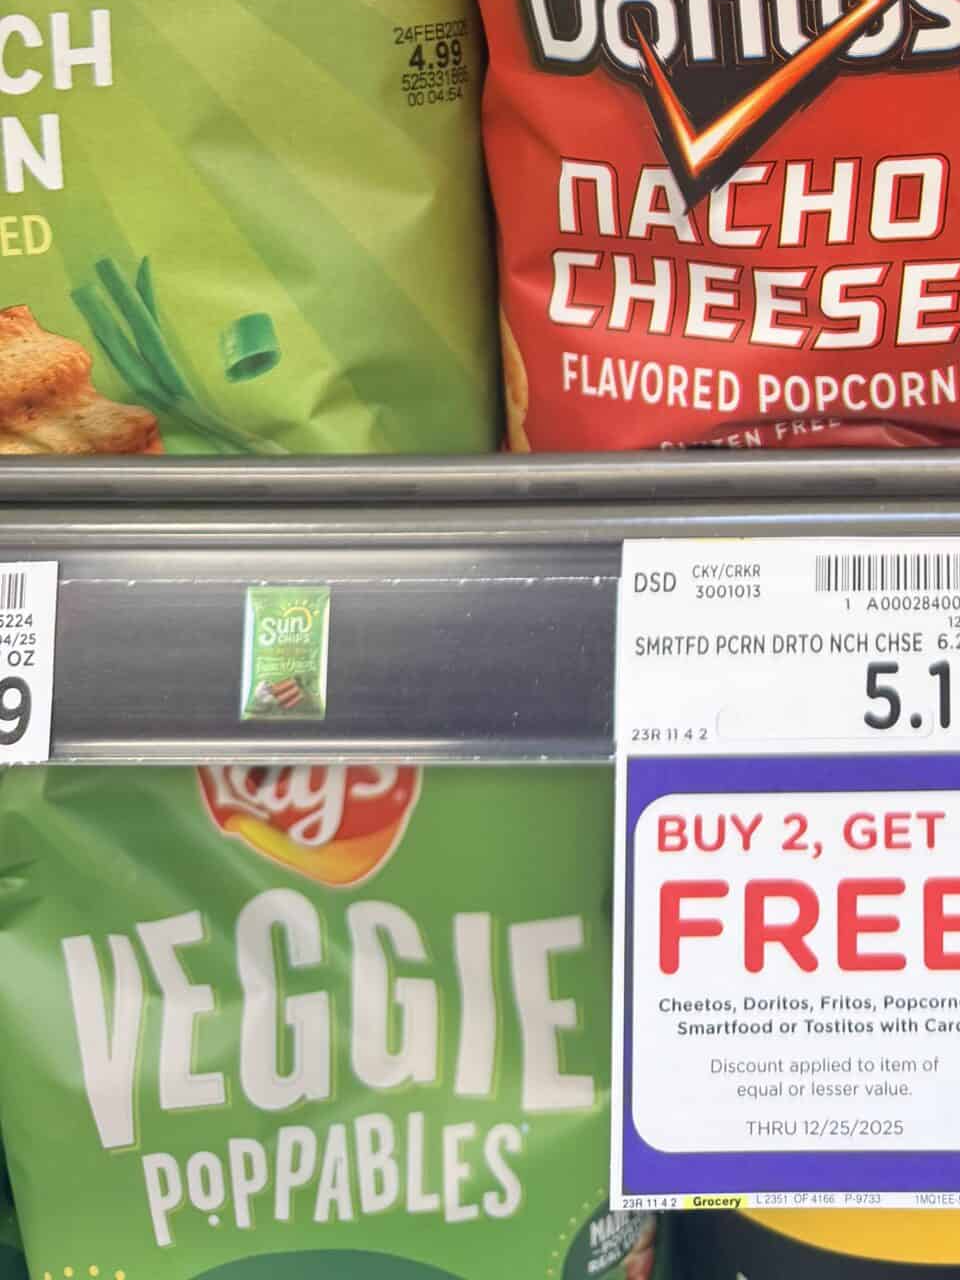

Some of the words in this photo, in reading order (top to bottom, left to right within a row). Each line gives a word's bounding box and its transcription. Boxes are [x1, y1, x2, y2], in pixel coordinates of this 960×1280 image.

[409, 39, 462, 71] 4.99
[556, 153, 950, 248] NACHO
[562, 352, 740, 413] FLAVORED
[758, 366, 957, 413] POPCORN
[634, 572, 677, 593] DSD
[692, 563, 761, 580] CKY/CRKR
[696, 585, 761, 599] 3001013
[259, 616, 305, 646] Sun
[635, 635, 709, 656] SMRTFD
[716, 634, 765, 655] PCRN
[772, 633, 823, 654] DRTO
[830, 633, 868, 653] NCH
[875, 633, 923, 652] CHSE
[7, 650, 36, 666] OZ
[632, 728, 661, 742] 23R
[667, 728, 678, 741] 11
[683, 728, 694, 741] 4
[699, 728, 708, 741] 2
[657, 812, 763, 853] BUY
[781, 811, 823, 860] 2,
[843, 810, 946, 851] GET
[658, 997, 737, 1014] Cheetos,
[743, 995, 815, 1013] Doritos,
[820, 994, 877, 1012] Fritos,
[61, 888, 596, 1149] VEGGIE
[677, 1019, 774, 1036] Smartfood
[779, 1022, 797, 1034] or
[806, 1018, 874, 1034] Tostitos
[880, 1017, 918, 1033] with
[710, 1058, 784, 1074] Discount
[789, 1056, 852, 1076] applied
[857, 1058, 875, 1072] to
[880, 1056, 917, 1072] item
[922, 1055, 940, 1072] of
[736, 1081, 783, 1100] equal
[787, 1084, 806, 1097] or
[811, 1080, 859, 1096] lesser
[865, 1080, 913, 1096] value.
[746, 1120, 797, 1136] THRU
[804, 1118, 904, 1137] 12/25/2025
[623, 1198, 643, 1209] 23R
[693, 1196, 742, 1209] Grocery
